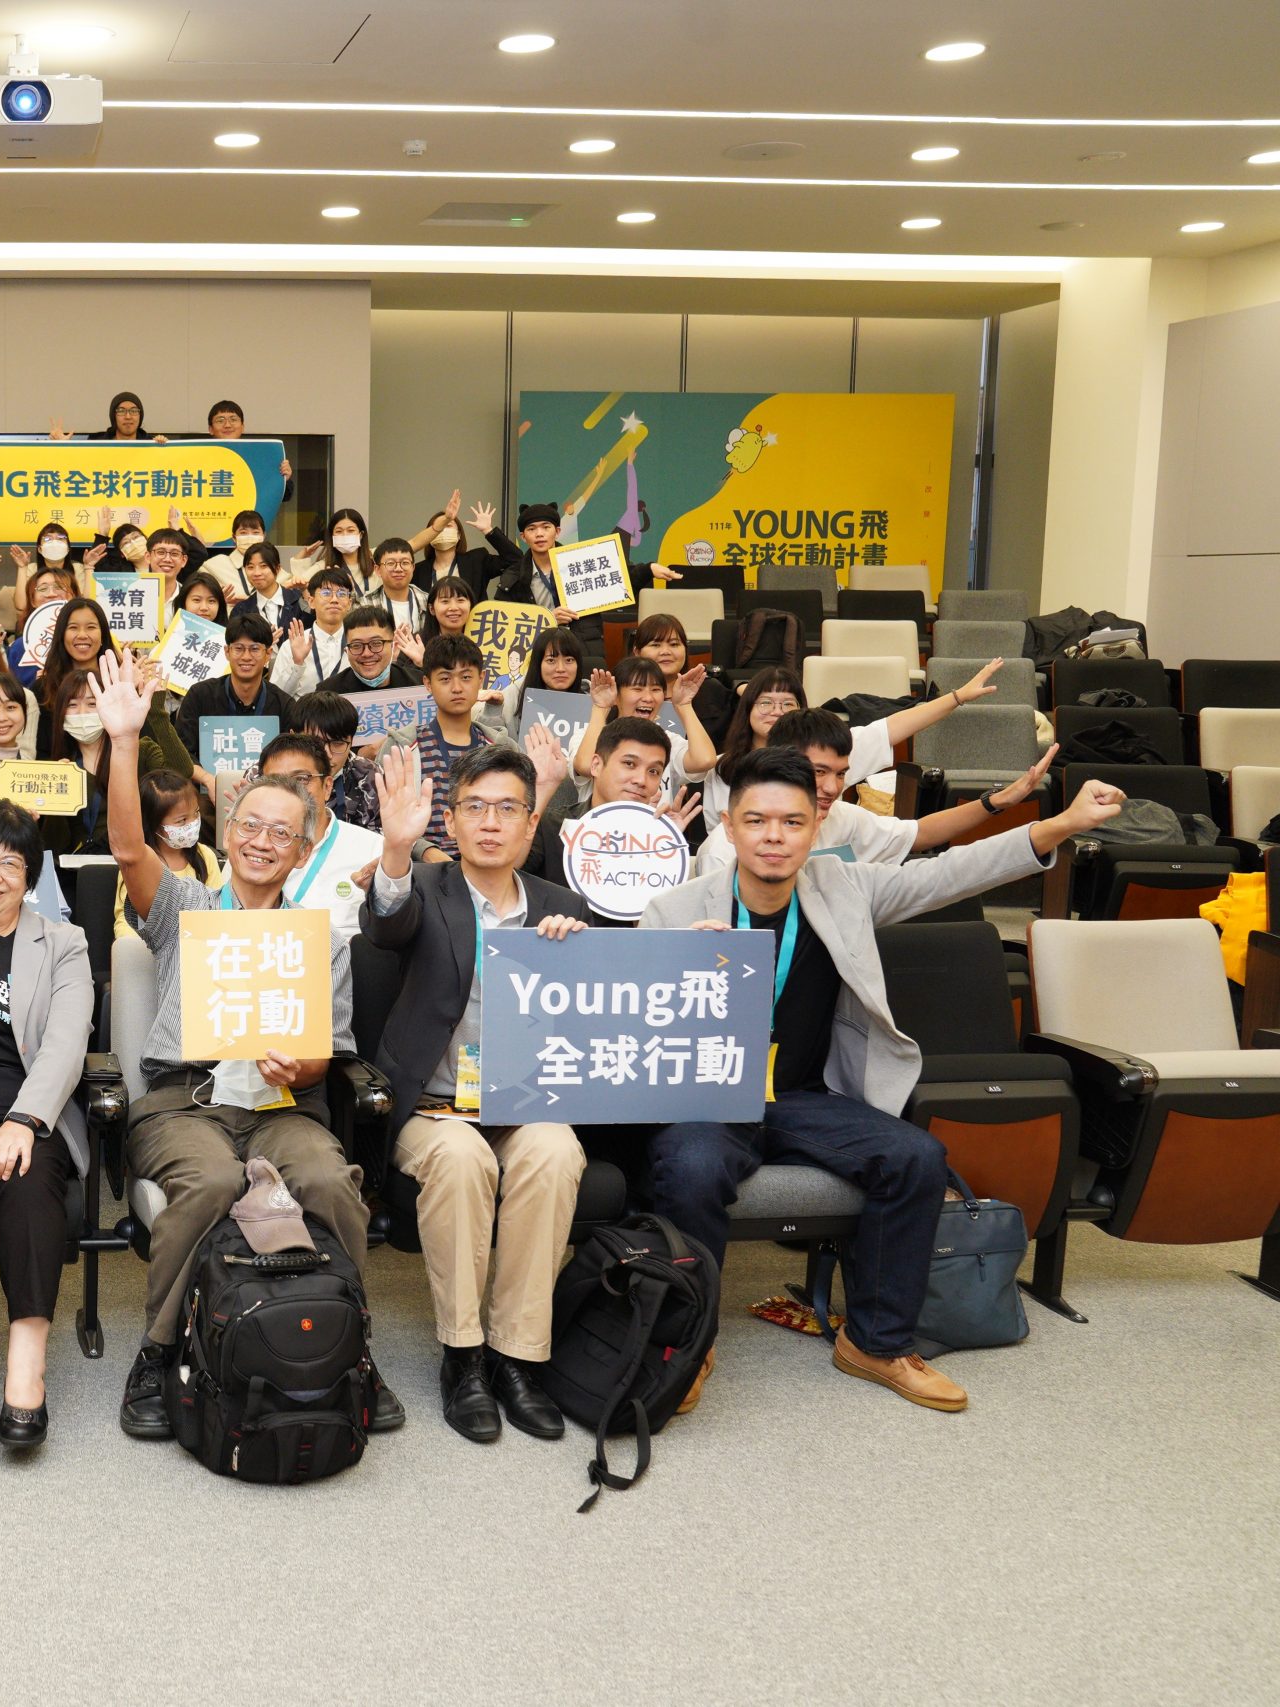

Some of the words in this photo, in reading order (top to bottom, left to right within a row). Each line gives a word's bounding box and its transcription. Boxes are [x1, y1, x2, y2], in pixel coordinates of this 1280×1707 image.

[733, 510, 889, 540] YOUNG飛
[567, 555, 612, 578] 就業及
[108, 588, 145, 607] 教育
[564, 570, 623, 597] 經濟成長
[109, 612, 145, 630] 品質
[470, 609, 550, 652] 我就
[182, 632, 223, 661] 永續
[212, 727, 266, 753] 社會
[10, 780, 68, 795] 行動計畫
[562, 823, 677, 860] YOUNG
[603, 871, 678, 887] ACTION
[206, 931, 306, 981] 在地
[207, 989, 305, 1037] 行動
[508, 970, 730, 1027] Young飛
[535, 1035, 745, 1086] 全球行動
